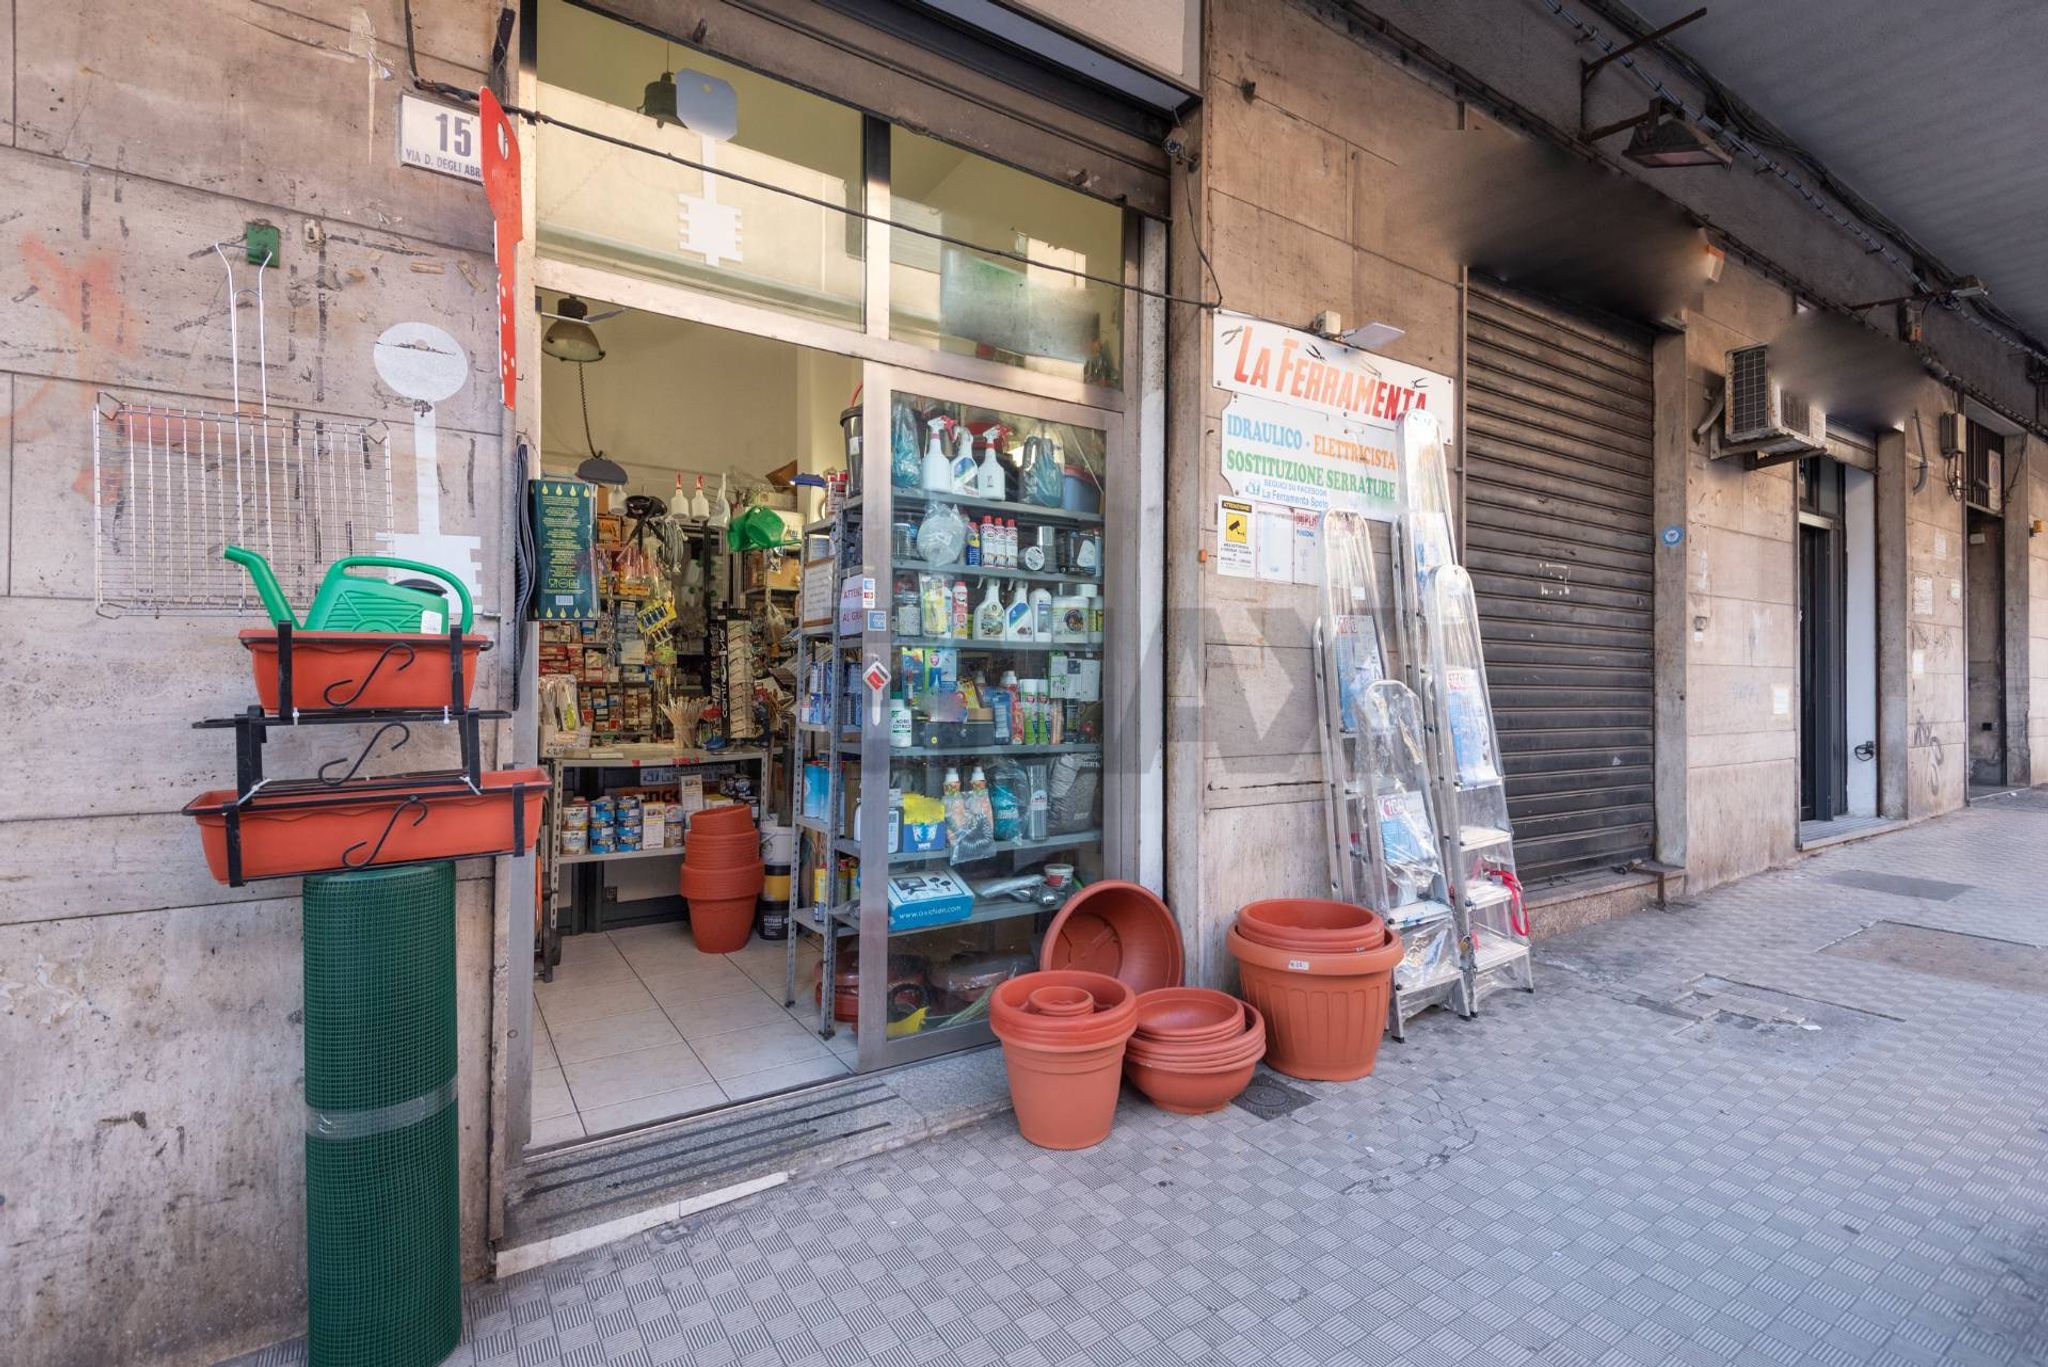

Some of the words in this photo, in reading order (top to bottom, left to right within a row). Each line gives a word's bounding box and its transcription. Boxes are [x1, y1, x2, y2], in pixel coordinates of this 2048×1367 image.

[435, 113, 472, 157] 15
[405, 147, 421, 162] VIA
[424, 153, 434, 167] D.
[436, 156, 462, 173] DEGLI
[1234, 326, 1271, 389] LA
[1275, 337, 1427, 421] FERRAMENTA
[1227, 413, 1302, 450] IDRAULICO
[1314, 434, 1396, 471] ELETTRICISTA
[1226, 449, 1324, 486] SOSTITUZIONE
[1327, 469, 1396, 500] SERRATURE
[1262, 488, 1271, 499] La
[1272, 490, 1309, 505] Ferramenta
